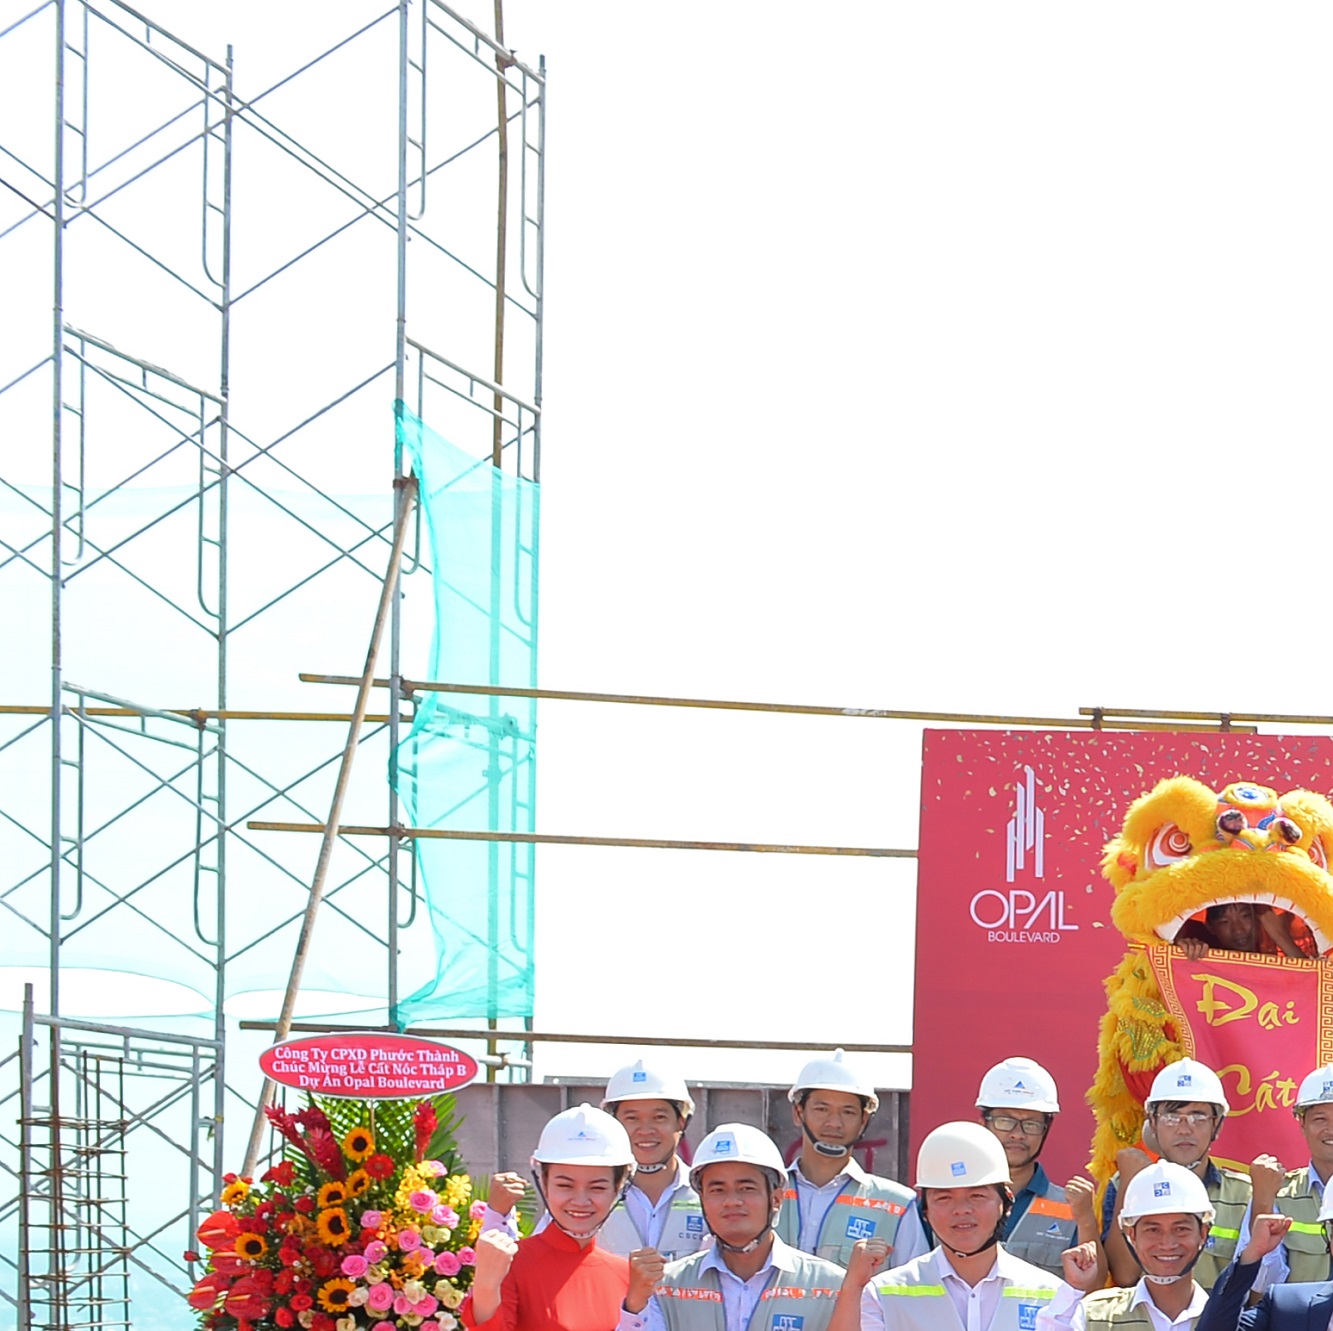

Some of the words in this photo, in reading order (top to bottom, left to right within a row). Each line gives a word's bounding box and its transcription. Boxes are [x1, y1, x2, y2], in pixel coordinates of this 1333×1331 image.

[970, 890, 1079, 930] OPAL
[988, 931, 1061, 943] BOULEVARD
[1190, 973, 1300, 1030] Đại
[275, 1047, 309, 1062] Công
[311, 1048, 328, 1062] Ty
[331, 1048, 367, 1061] CPXD
[370, 1049, 414, 1062] Phước
[417, 1049, 459, 1063] Thành
[272, 1060, 305, 1073] Chúc
[308, 1062, 347, 1077] Mừng
[350, 1061, 365, 1074] Lễ
[393, 1061, 417, 1075] Nóc
[420, 1062, 454, 1078] Tháp
[457, 1065, 467, 1076] B
[299, 1076, 320, 1090] Dự
[322, 1072, 342, 1088] Án
[344, 1076, 375, 1090] Opal
[378, 1077, 445, 1089] Boulevard
[1216, 1064, 1299, 1117] Cát
